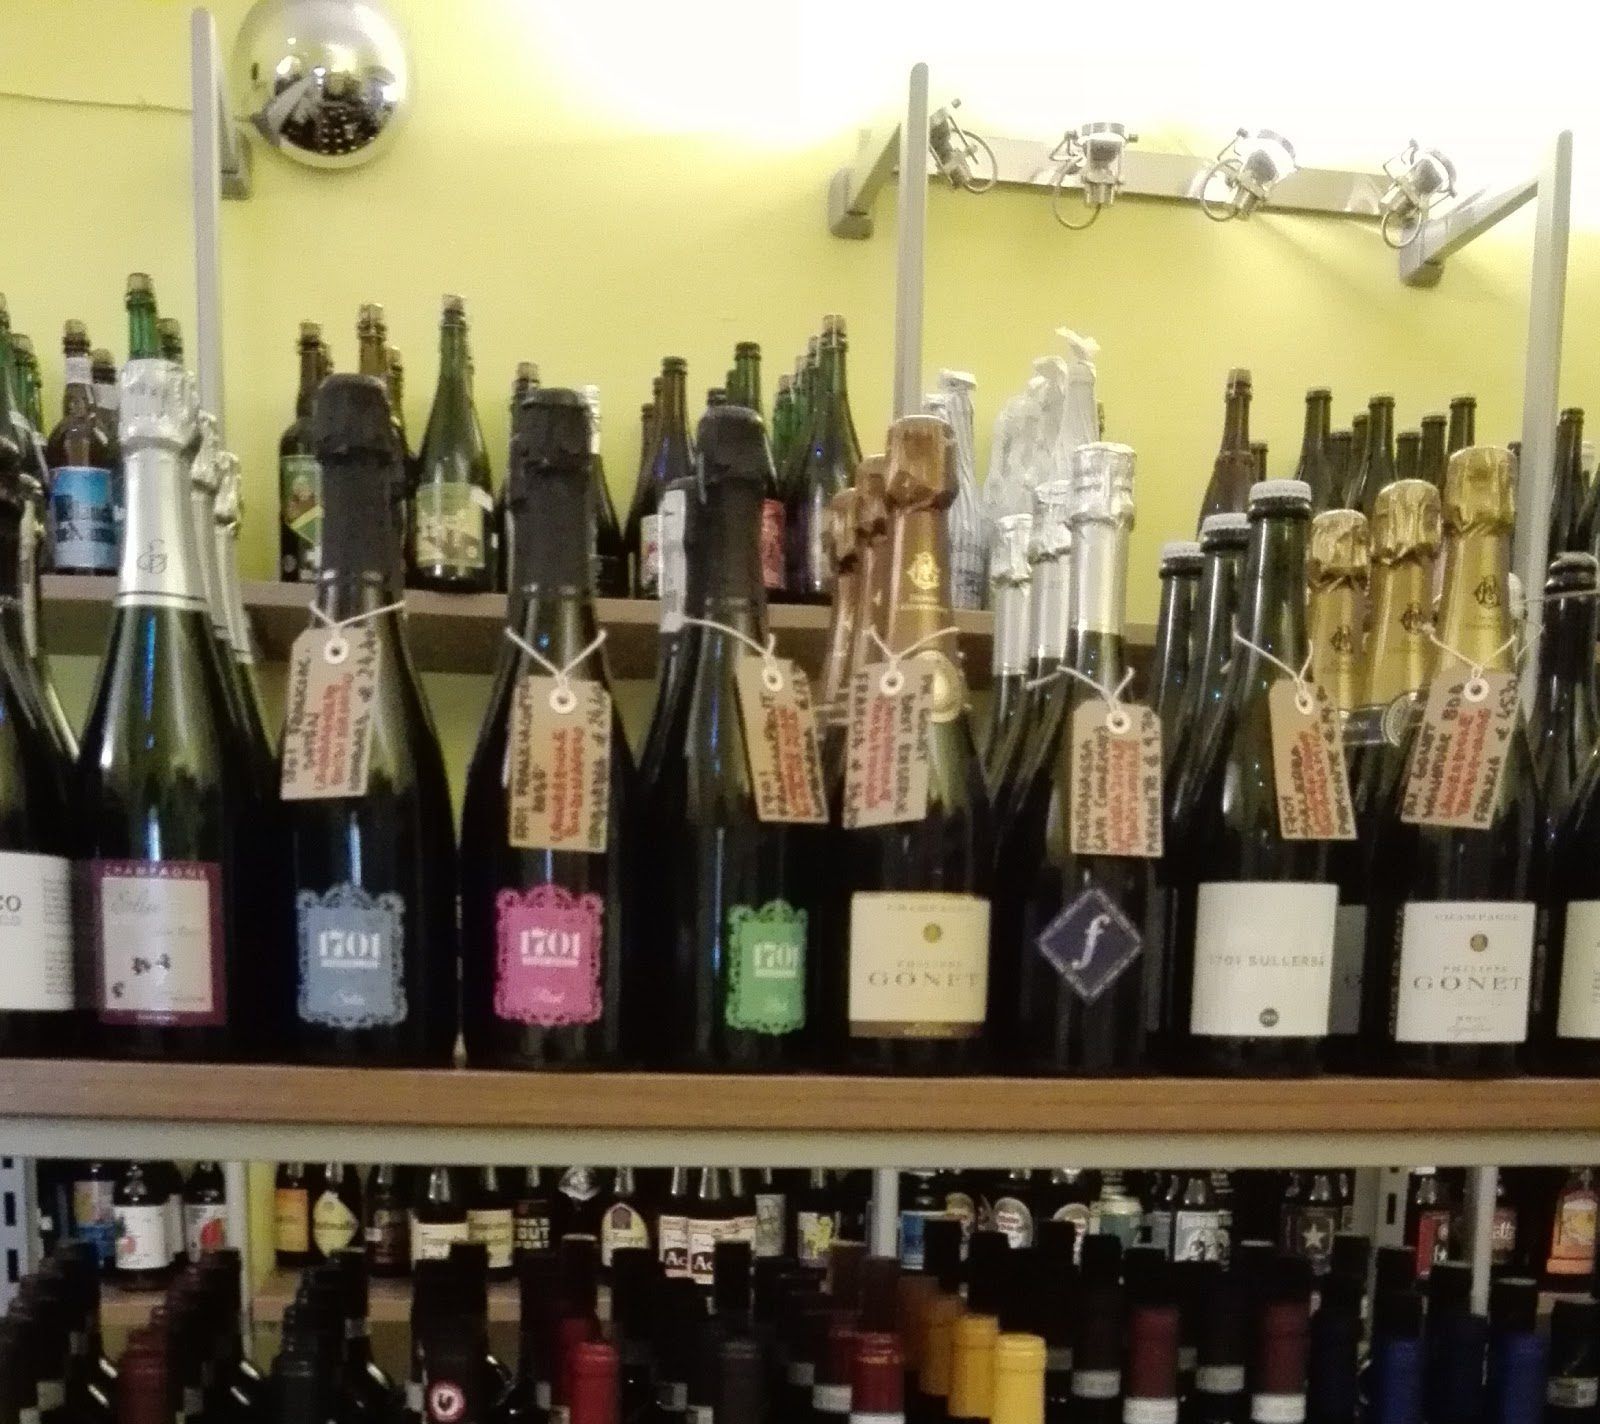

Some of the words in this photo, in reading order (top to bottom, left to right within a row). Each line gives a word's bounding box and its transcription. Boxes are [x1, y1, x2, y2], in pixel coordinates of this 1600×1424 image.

[318, 930, 381, 962] 1701
[520, 928, 581, 958] 1701
[1413, 975, 1524, 990] GONET
